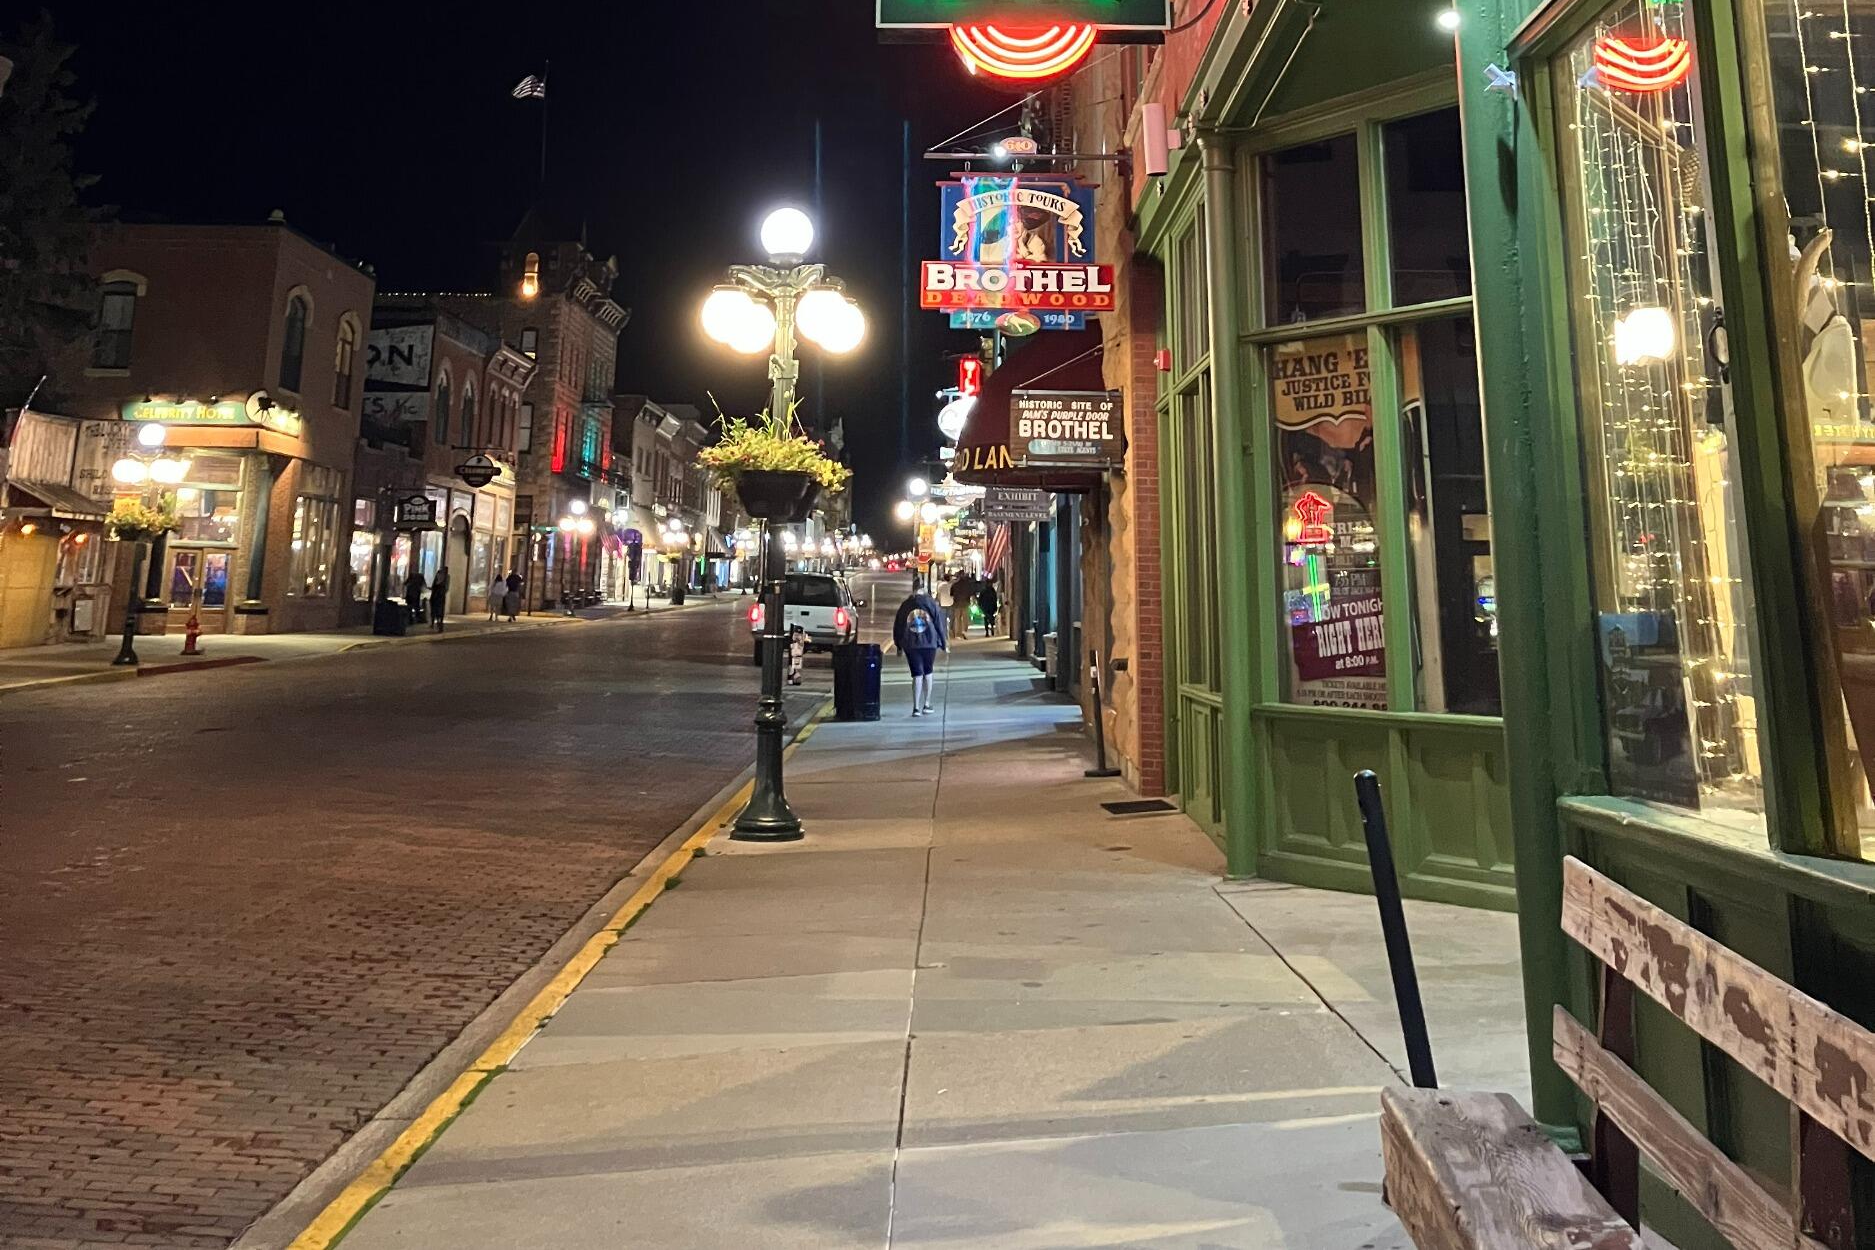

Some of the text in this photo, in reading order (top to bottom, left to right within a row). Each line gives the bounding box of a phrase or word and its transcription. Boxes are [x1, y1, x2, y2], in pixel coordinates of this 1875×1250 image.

[1029, 192, 1066, 212] TOURS
[926, 263, 1112, 293] BROTHEL
[927, 292, 1110, 306] DEADWOOD
[1273, 348, 1369, 380] HANG 'E
[1282, 371, 1370, 396] JUSTICE F
[1019, 400, 1113, 410] HISTORIC SITE OF
[1293, 390, 1371, 411] WILD BIL
[134, 405, 235, 420] CELEBRITY HOTEL
[1022, 410, 1110, 421] PAM'S PURPLE DOOR
[1018, 419, 1114, 440] BROTHEL
[998, 492, 1038, 501] EXHIBIT
[1342, 597, 1383, 618] TONIGH
[1316, 620, 1353, 658] RIGHT
[1335, 660, 1345, 670] at
